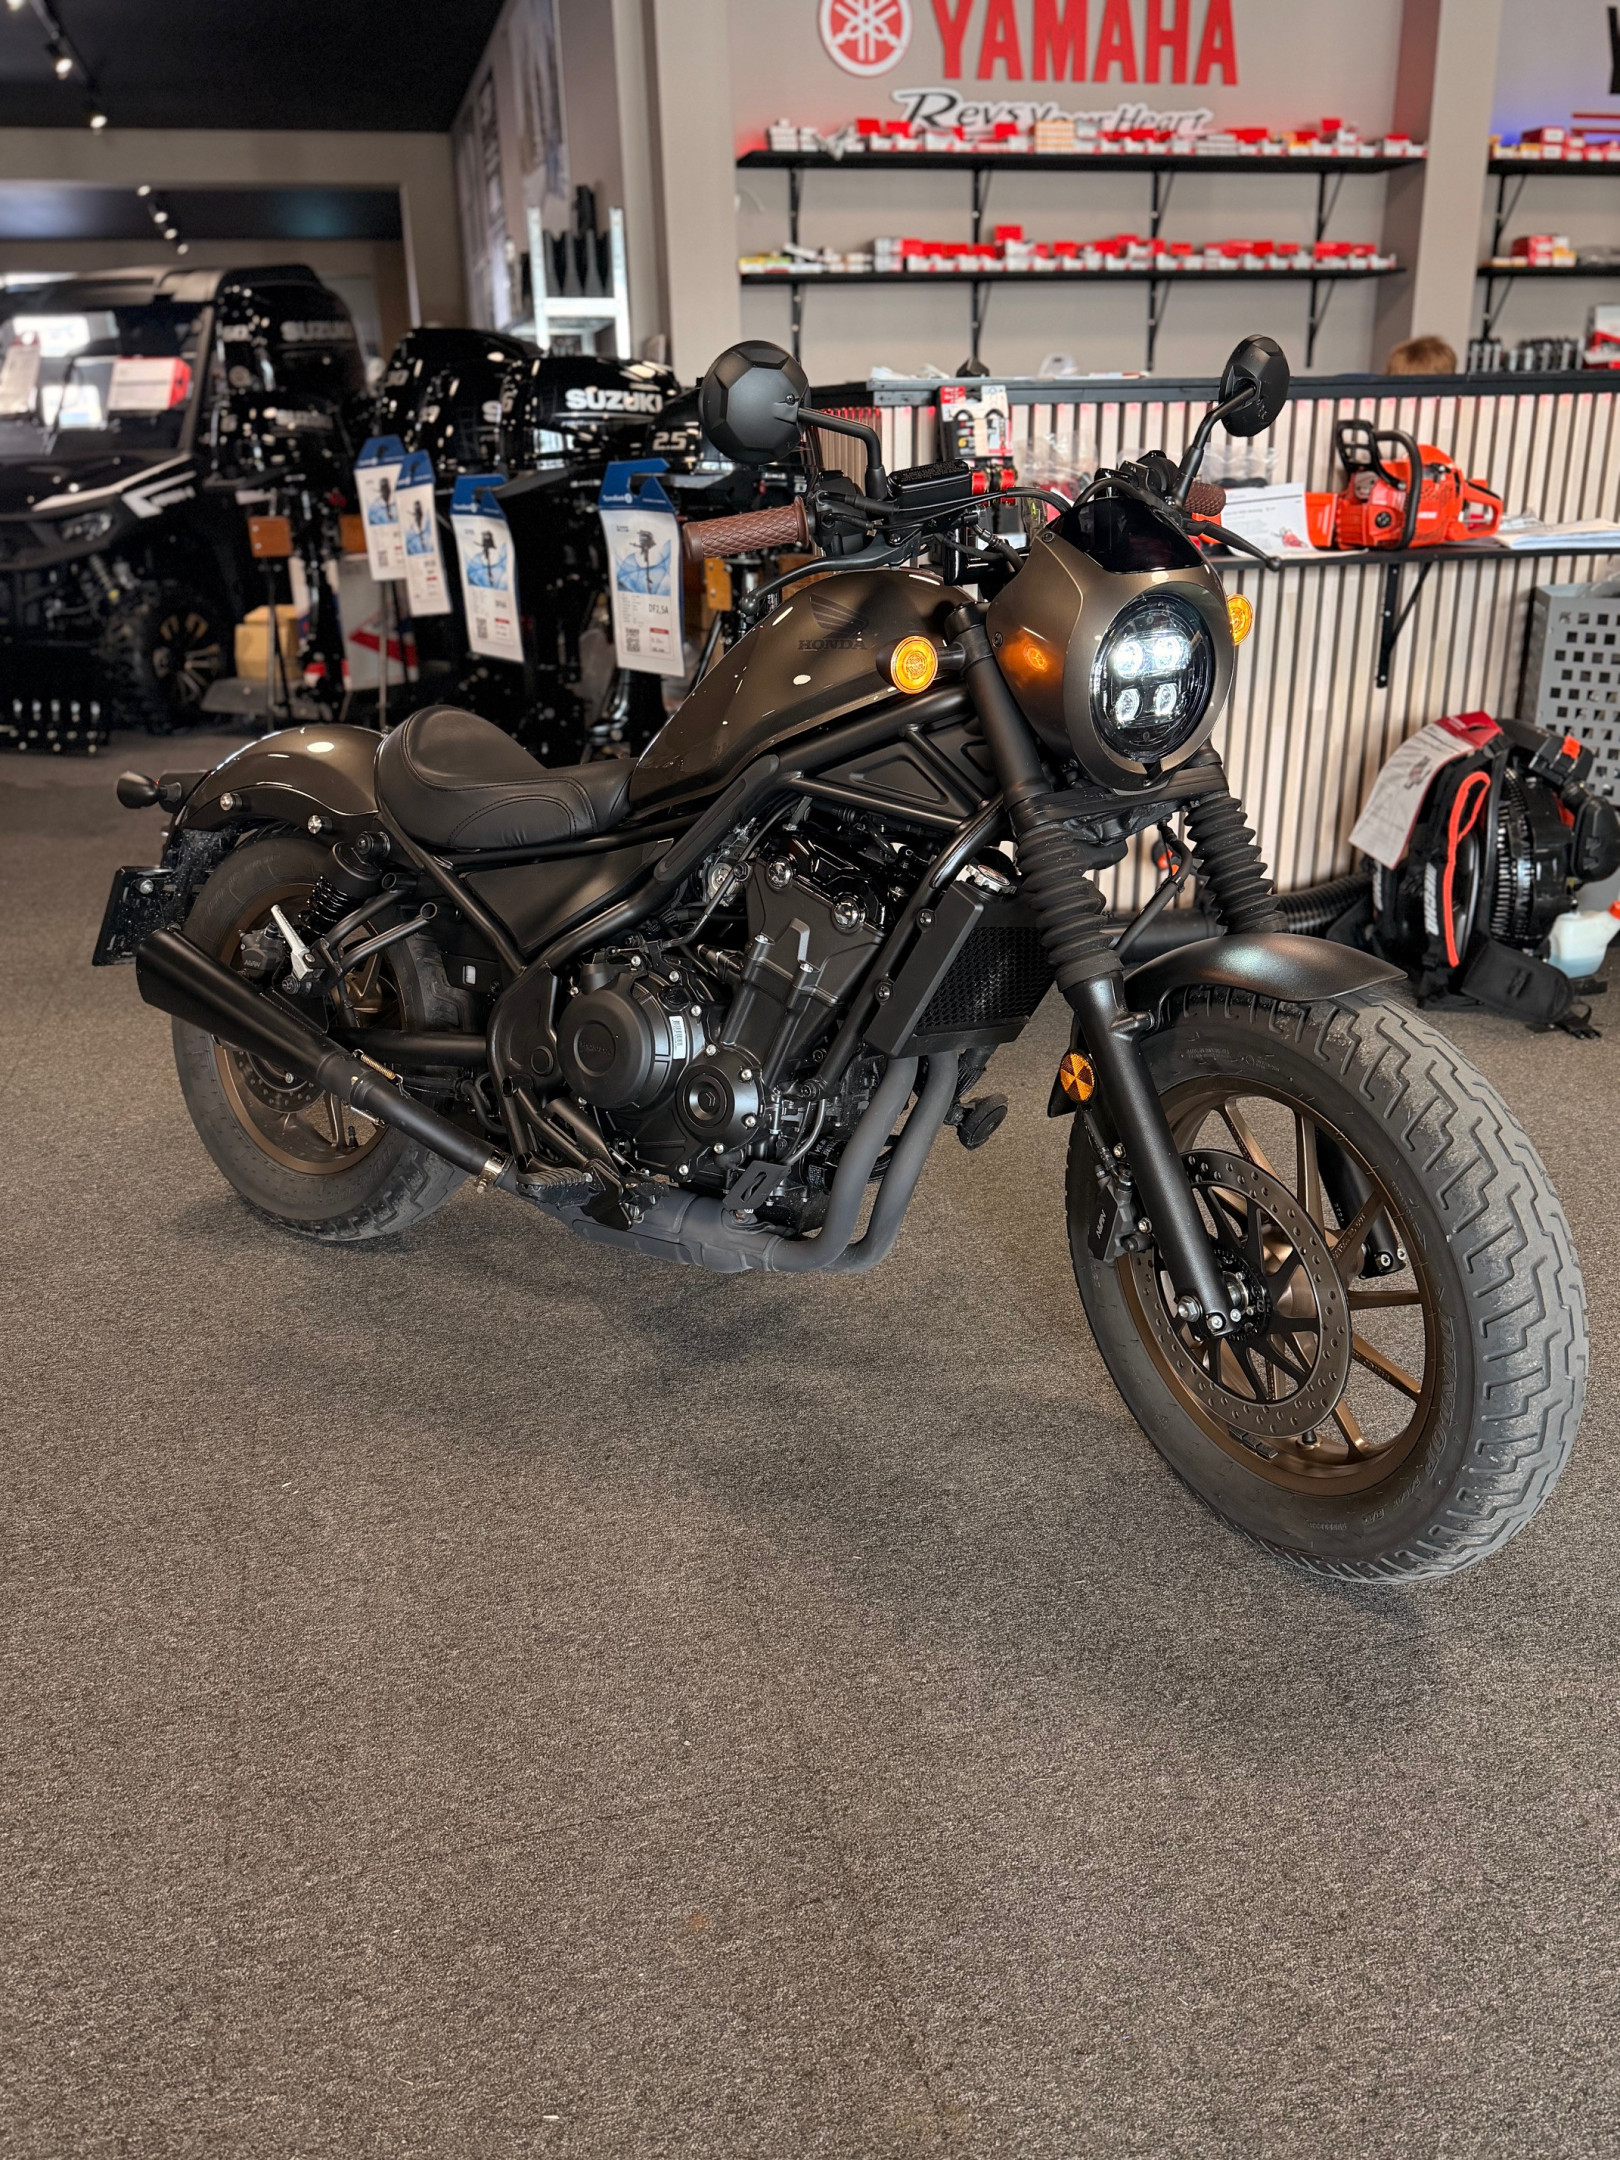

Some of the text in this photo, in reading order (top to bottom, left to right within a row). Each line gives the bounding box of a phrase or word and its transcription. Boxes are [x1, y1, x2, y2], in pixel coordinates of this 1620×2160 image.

[930, 0, 1238, 86] YAMAHA
[898, 91, 1020, 130] Revs
[565, 388, 663, 413] SUZUKI
[798, 639, 868, 651] HONDA
[1424, 1311, 1458, 1478] DUNLOP
